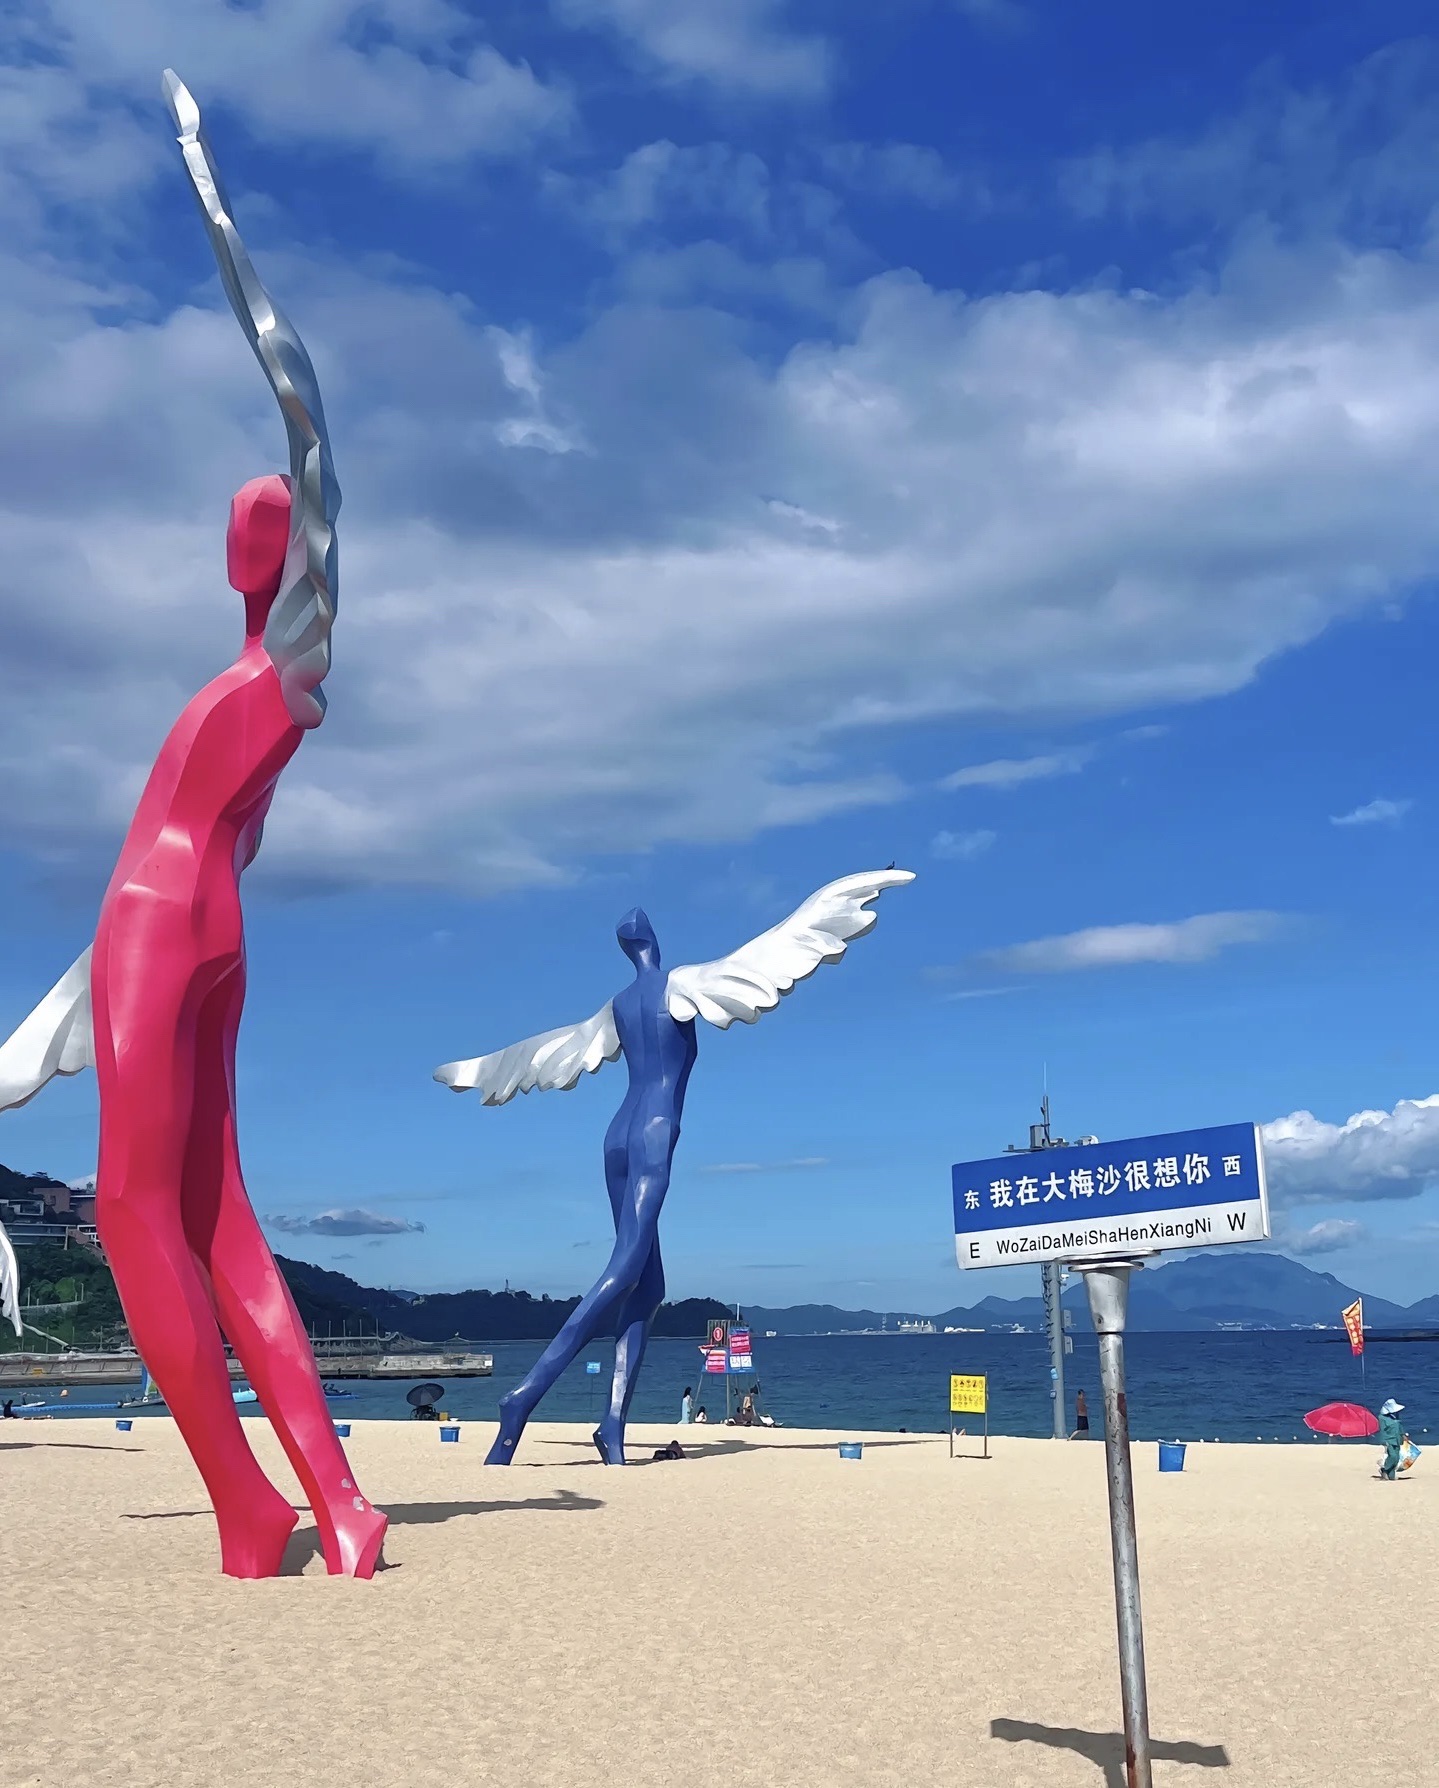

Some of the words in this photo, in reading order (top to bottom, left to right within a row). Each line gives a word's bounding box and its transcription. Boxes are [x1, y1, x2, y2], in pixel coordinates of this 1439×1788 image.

[963, 1189, 981, 1210] 东
[989, 1153, 1211, 1209] 我在大梅沙很想你
[1221, 1154, 1242, 1177] 西
[970, 1242, 981, 1259] E
[996, 1217, 1212, 1254] WoZaiDaMeiShaHenXiangNi
[1227, 1212, 1246, 1231] W
